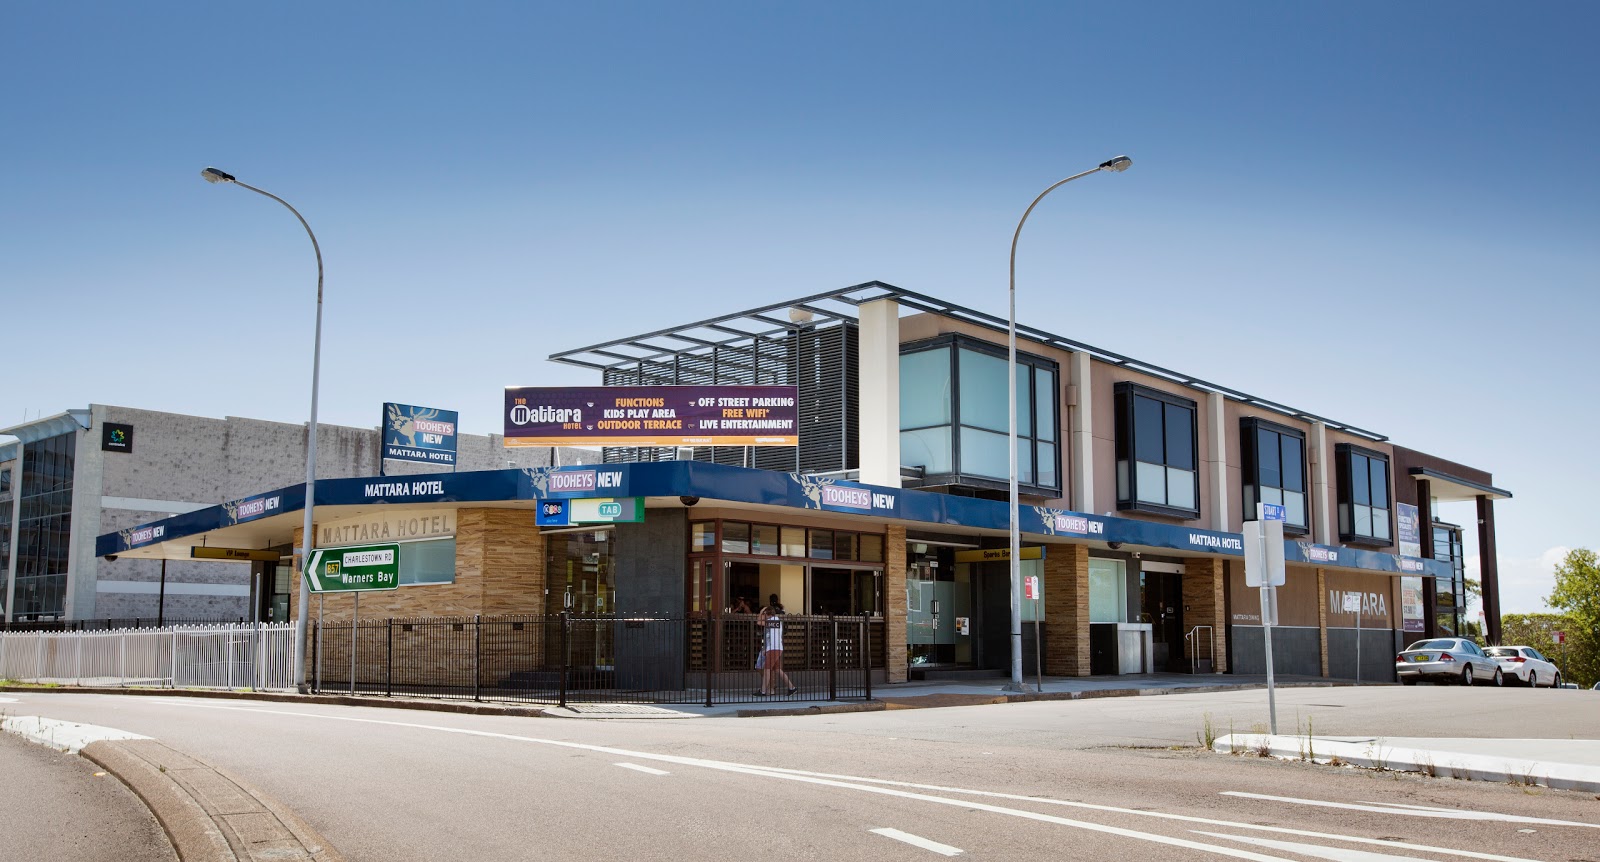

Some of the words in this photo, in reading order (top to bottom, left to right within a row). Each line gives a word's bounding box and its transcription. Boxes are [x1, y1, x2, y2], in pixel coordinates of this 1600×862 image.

[615, 398, 665, 408] FUNCTIONS
[698, 398, 715, 407] OFF
[717, 398, 750, 407] STREET
[752, 398, 795, 407] PARKING
[603, 409, 625, 419] KIDS
[627, 409, 650, 419] PLAY
[651, 409, 676, 418] AREA
[722, 408, 744, 418] FREE
[415, 421, 452, 434] TOOHEYS
[597, 420, 641, 430] OUTDOOR
[643, 420, 682, 430] TERRACE
[699, 420, 718, 429] LIVE
[720, 420, 793, 429] ENTERTAINMENT
[422, 433, 444, 445] NEW
[389, 448, 427, 459] MATTARA
[429, 453, 453, 462] HOTEL
[552, 474, 593, 489] TOOHEYS
[597, 472, 622, 487] NEW
[364, 483, 410, 498] MATTARA
[412, 481, 445, 496] HOTEL
[825, 488, 869, 506] TOOHEYS
[872, 493, 895, 510] NEW
[239, 500, 264, 516] TOOHEYS
[265, 496, 280, 510] NEW
[601, 506, 618, 514] TAB
[323, 521, 390, 543] MATTARA
[398, 515, 451, 537] HOTEL
[1057, 517, 1086, 531] TOOHEYS
[1088, 520, 1104, 534] NEW
[131, 530, 152, 543] TOOHEYS
[153, 526, 165, 538] NEW
[1189, 533, 1221, 547] MATTARA
[1222, 537, 1242, 550] HOTEL
[344, 553, 382, 564] CHARLESTOWN
[384, 552, 393, 561] RD
[326, 563, 339, 574] B57
[342, 572, 374, 584] Warners
[377, 571, 394, 584] Bay
[1329, 589, 1387, 616] MAARA
